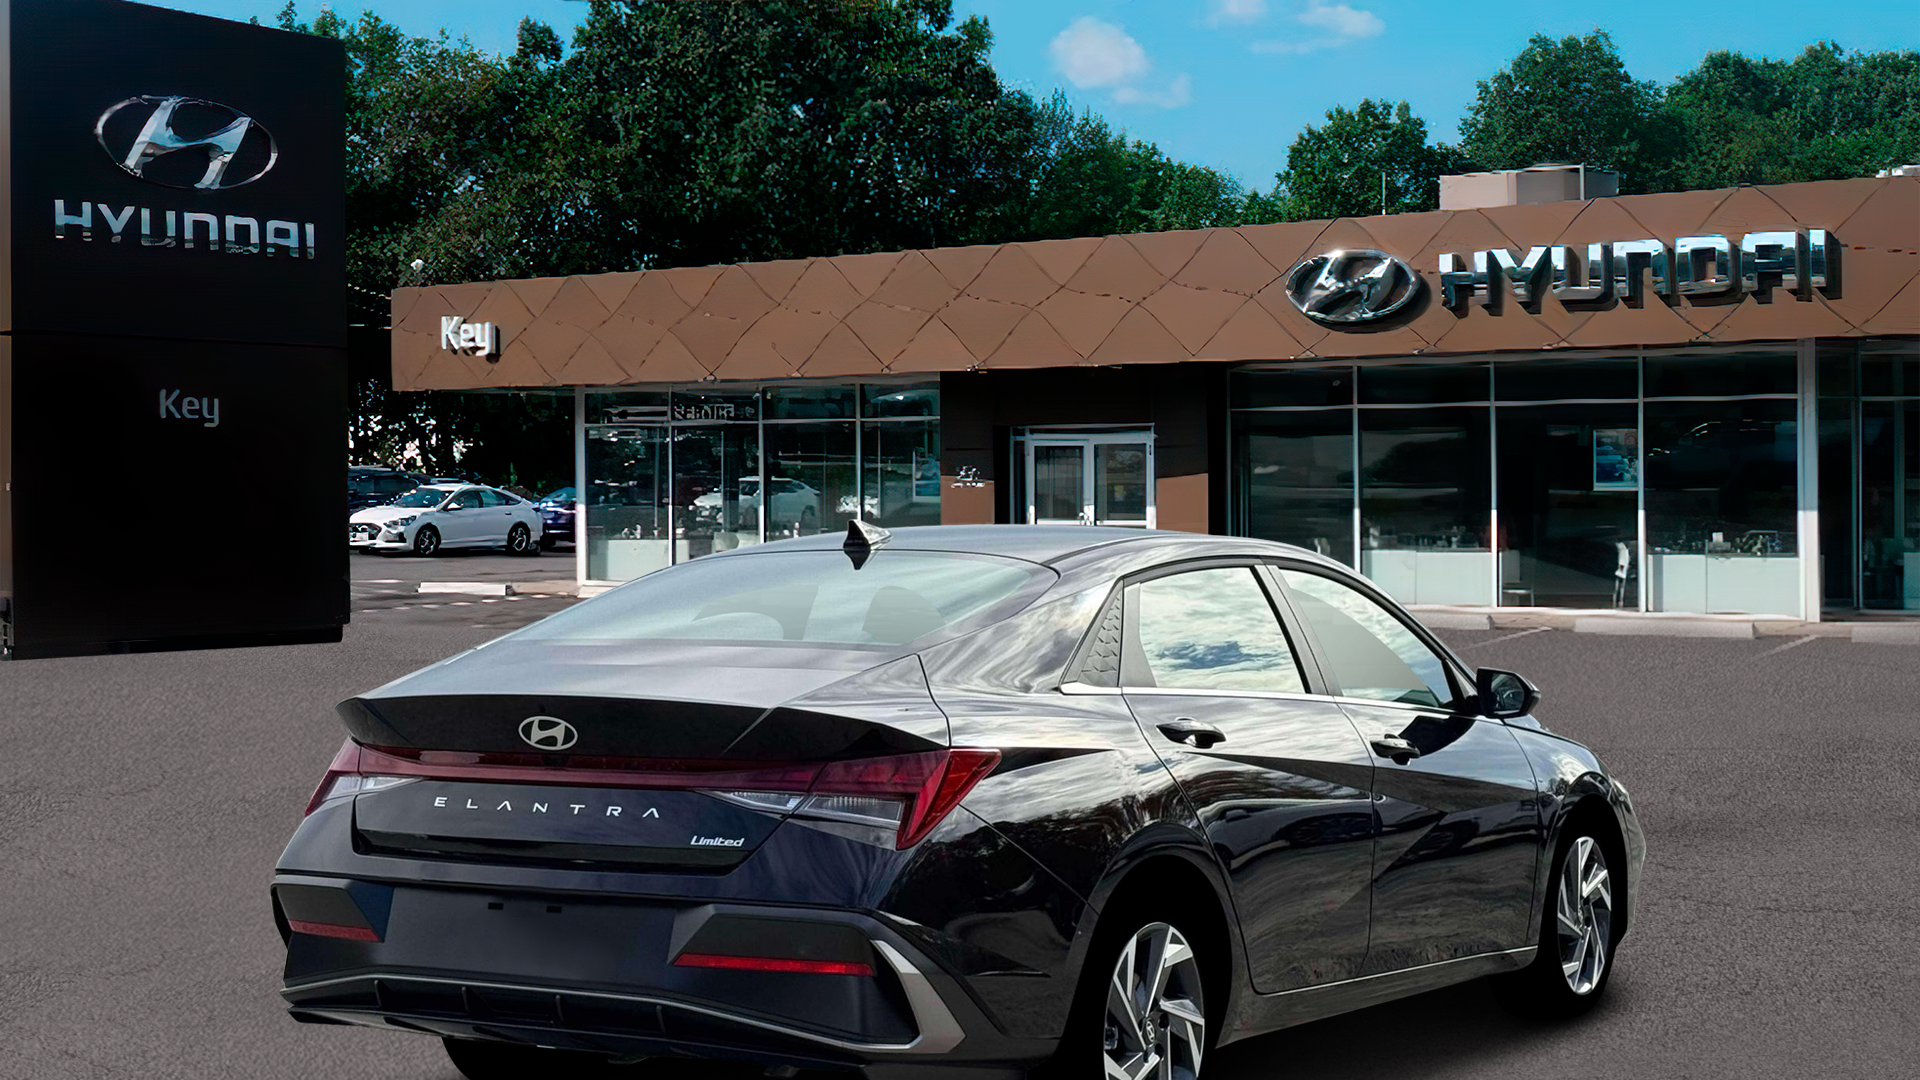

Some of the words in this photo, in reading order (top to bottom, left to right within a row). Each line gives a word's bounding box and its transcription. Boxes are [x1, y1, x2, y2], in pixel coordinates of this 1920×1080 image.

[54, 199, 315, 260] HYUNDAI
[1438, 228, 1832, 315] HYUNDAI
[440, 315, 496, 357] Key
[159, 388, 220, 428] Key
[434, 796, 660, 819] ELANTRA
[690, 835, 745, 848] Limited
